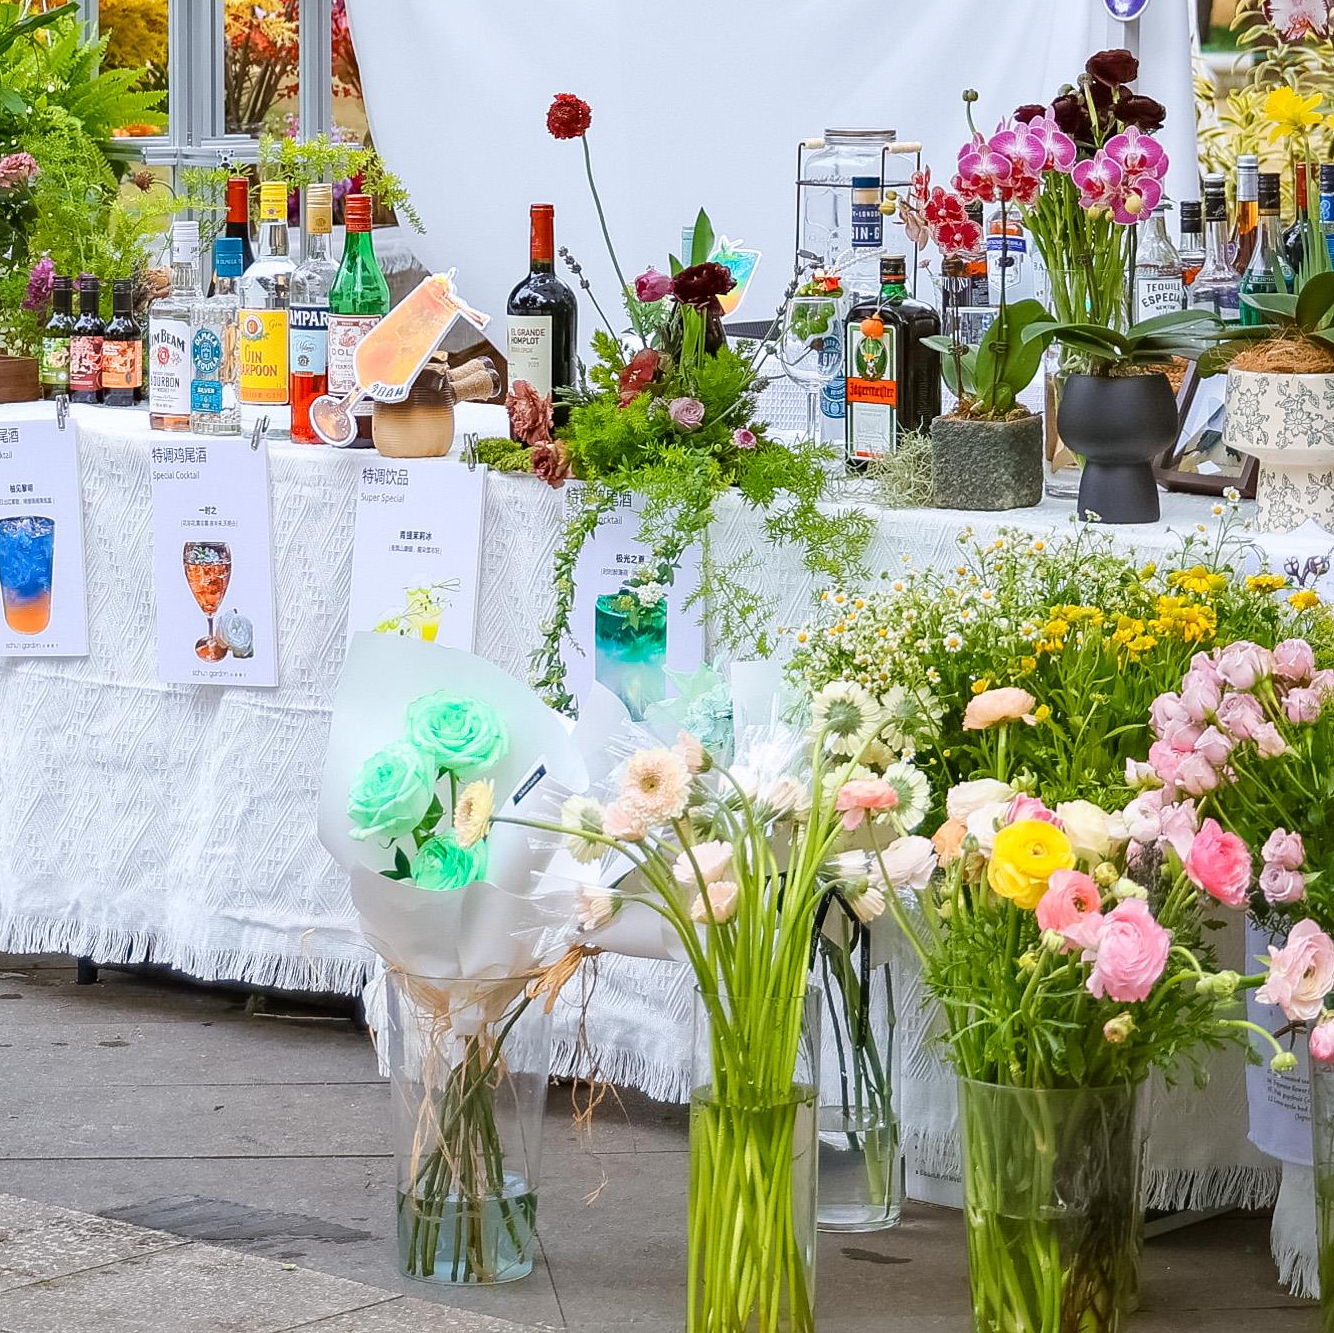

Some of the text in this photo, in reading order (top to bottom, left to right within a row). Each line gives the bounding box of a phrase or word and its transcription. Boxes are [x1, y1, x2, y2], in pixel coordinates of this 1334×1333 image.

[194, 332, 219, 347] OLMECA
[517, 328, 545, 337] GRANDE
[161, 329, 185, 353] BEAM
[511, 337, 540, 345] HOMPLOT
[194, 355, 219, 370] TEQUILA
[152, 447, 207, 464] 特调鸡尾酒
[153, 470, 200, 481] Special Cocktail
[362, 467, 409, 486] 特调饮品
[361, 492, 405, 505] Super Special
